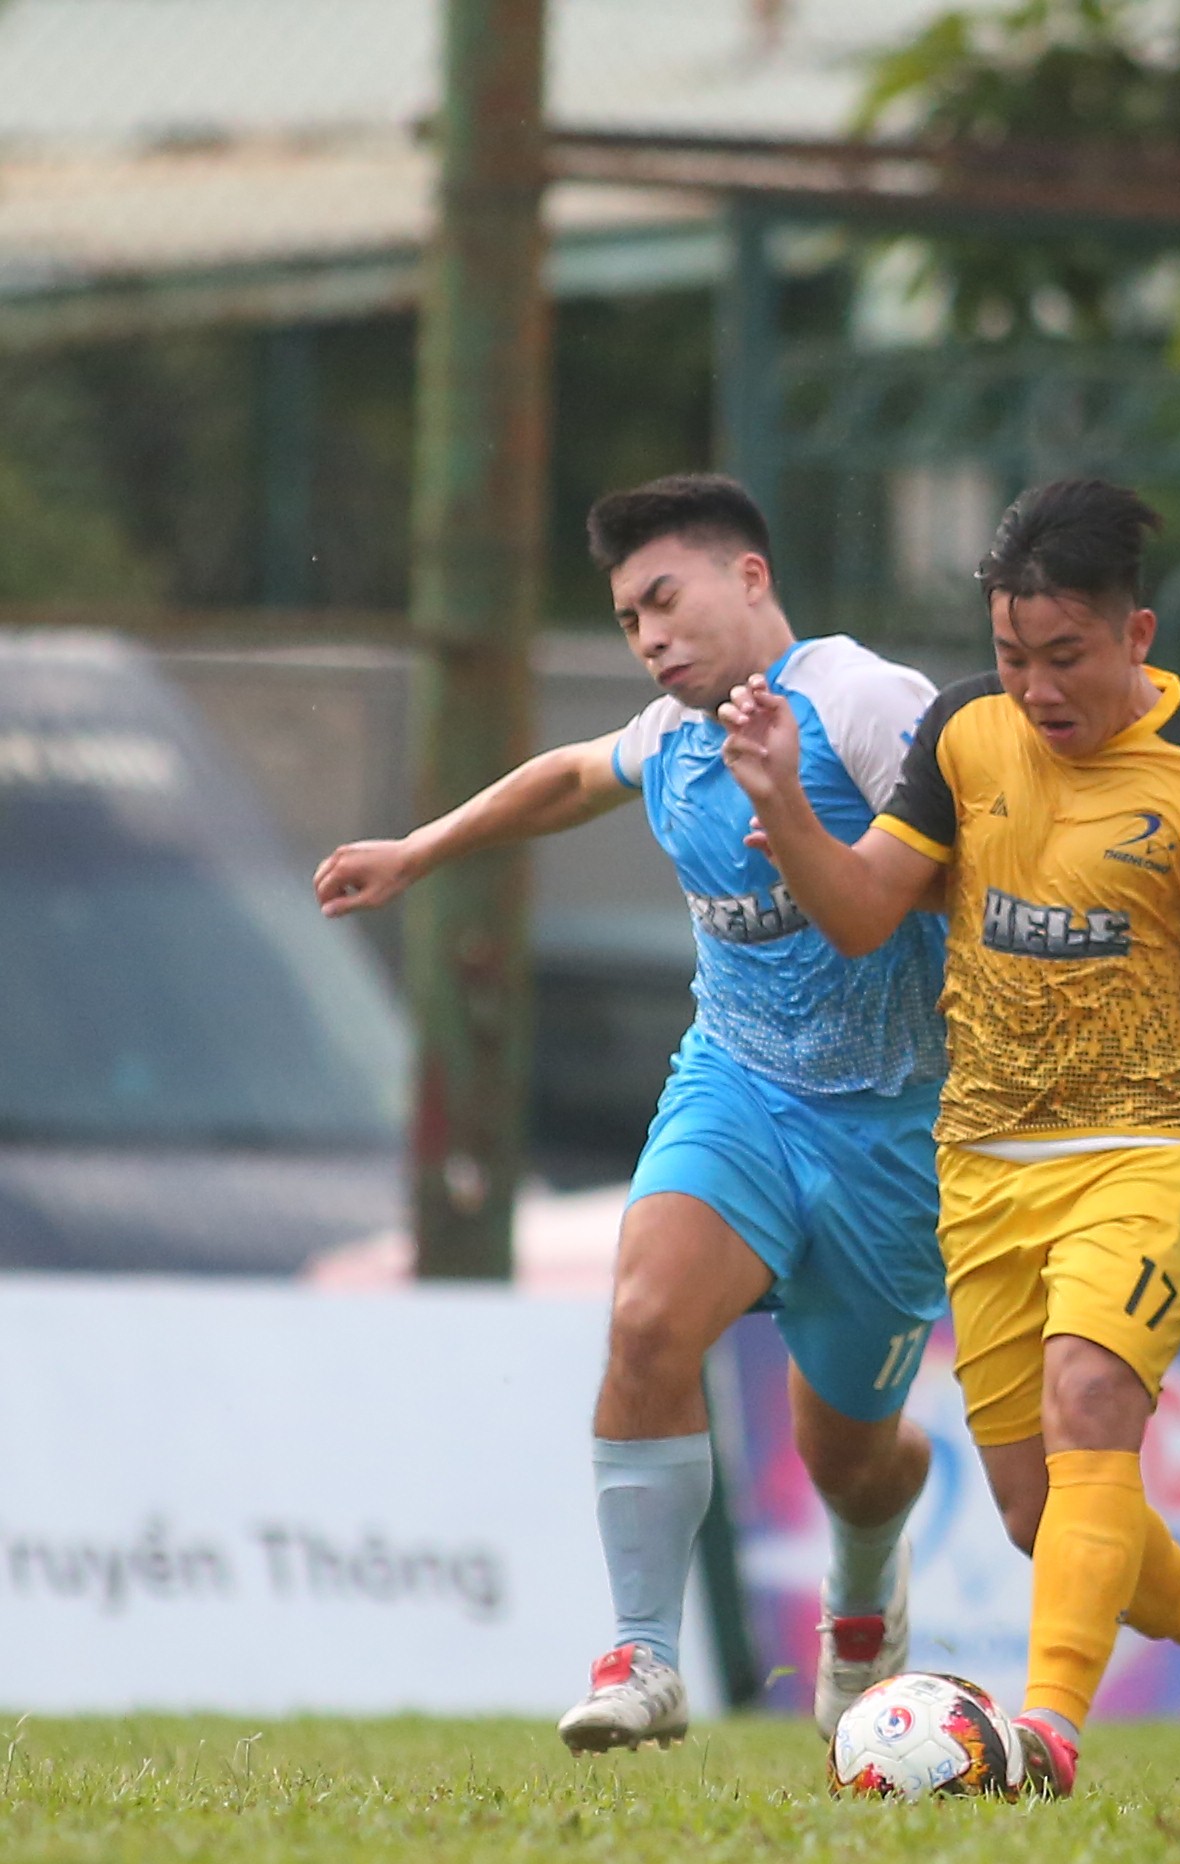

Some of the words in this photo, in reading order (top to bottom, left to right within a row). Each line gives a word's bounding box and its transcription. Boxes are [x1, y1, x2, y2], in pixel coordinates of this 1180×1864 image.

[983, 886, 1131, 959] HELE
[1124, 1255, 1178, 1331] 17
[0, 1510, 236, 1618] ruyền
[252, 1515, 510, 1622] Thông
